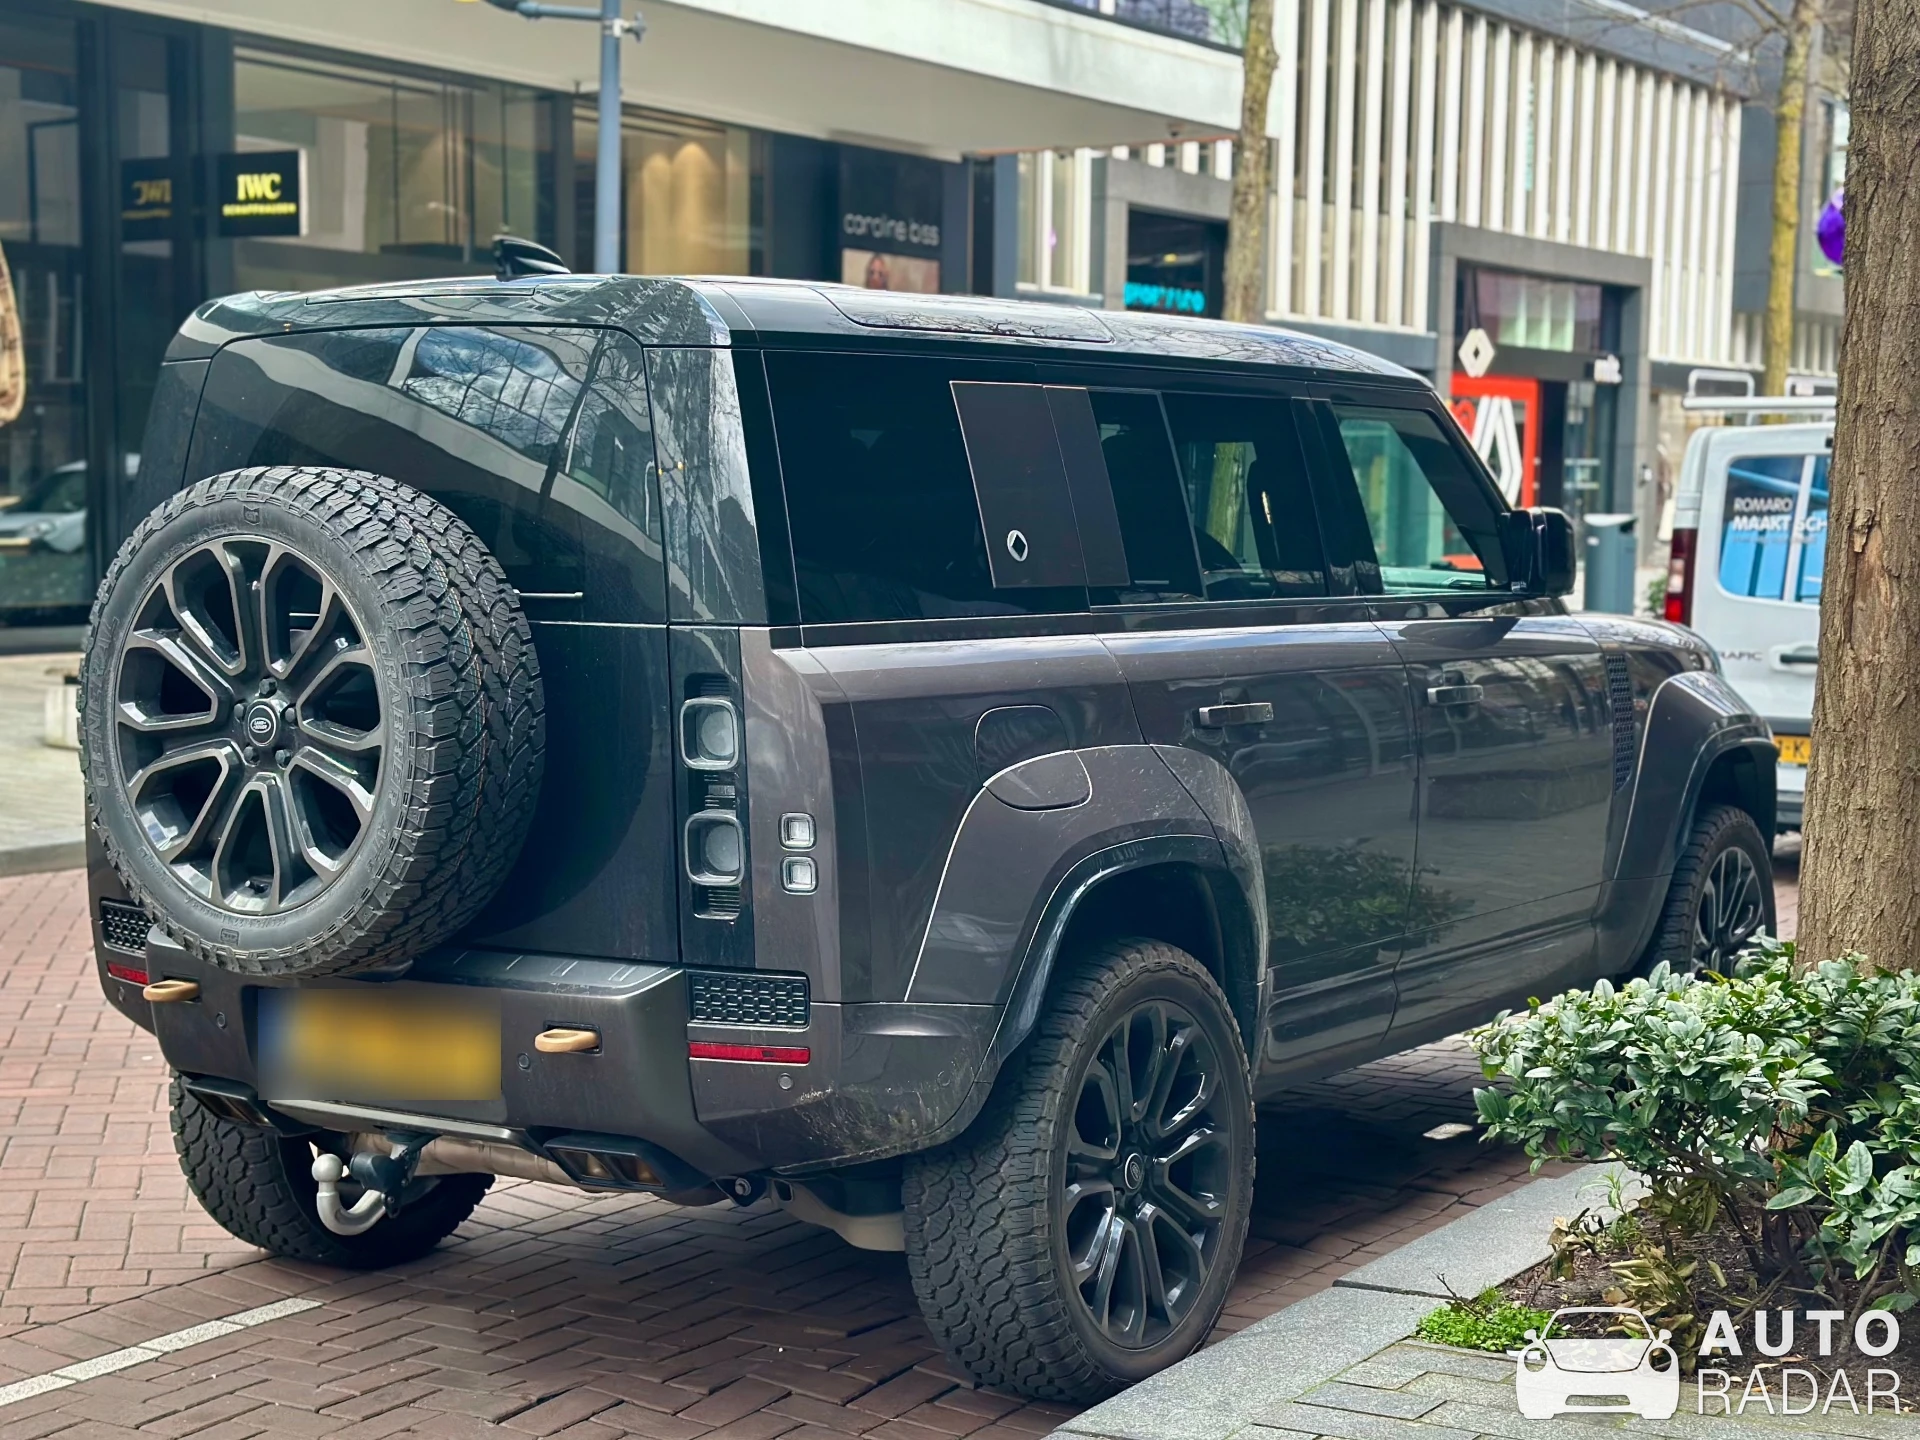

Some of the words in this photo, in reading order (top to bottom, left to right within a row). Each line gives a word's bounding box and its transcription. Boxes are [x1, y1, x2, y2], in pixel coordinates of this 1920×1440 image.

[237, 173, 281, 201] IWC
[1733, 497, 1793, 512] ROMARO
[1733, 514, 1791, 531] MAAKT
[375, 633, 405, 807] GRABBER
